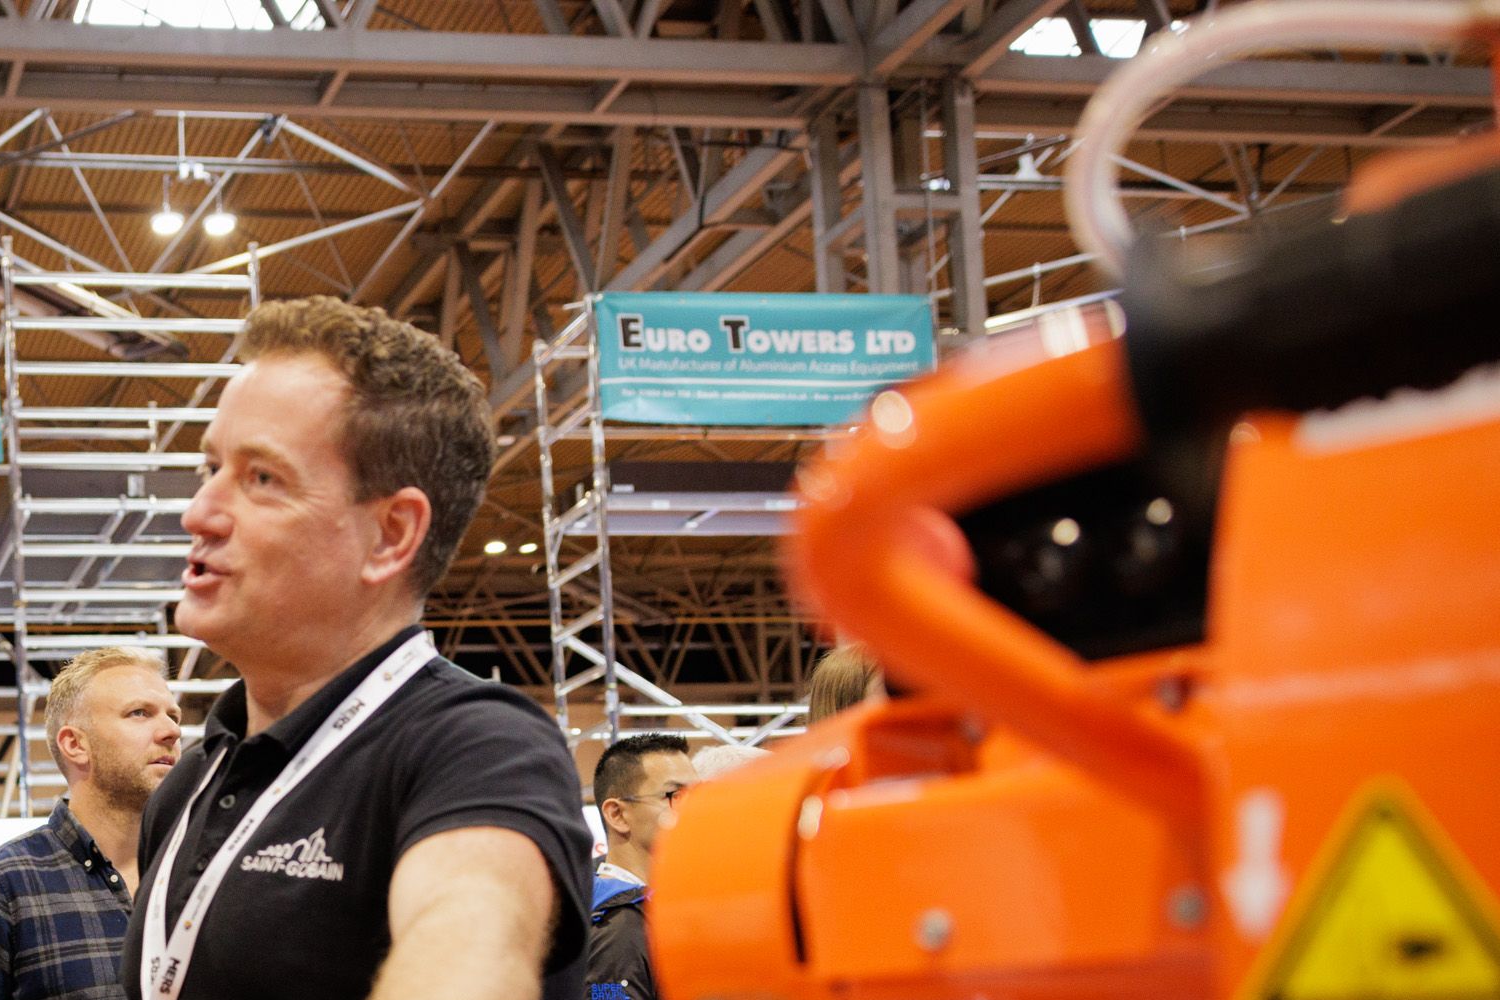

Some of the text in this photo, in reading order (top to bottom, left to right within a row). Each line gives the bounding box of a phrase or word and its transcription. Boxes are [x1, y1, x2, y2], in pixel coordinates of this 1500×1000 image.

[865, 329, 917, 355] LTD
[618, 357, 636, 370] UK
[723, 358, 737, 371] of
[809, 360, 849, 374] Access
[850, 361, 919, 376] Equipment
[240, 855, 345, 881] SAINT-GOBAIN
[159, 956, 182, 995] MERS
